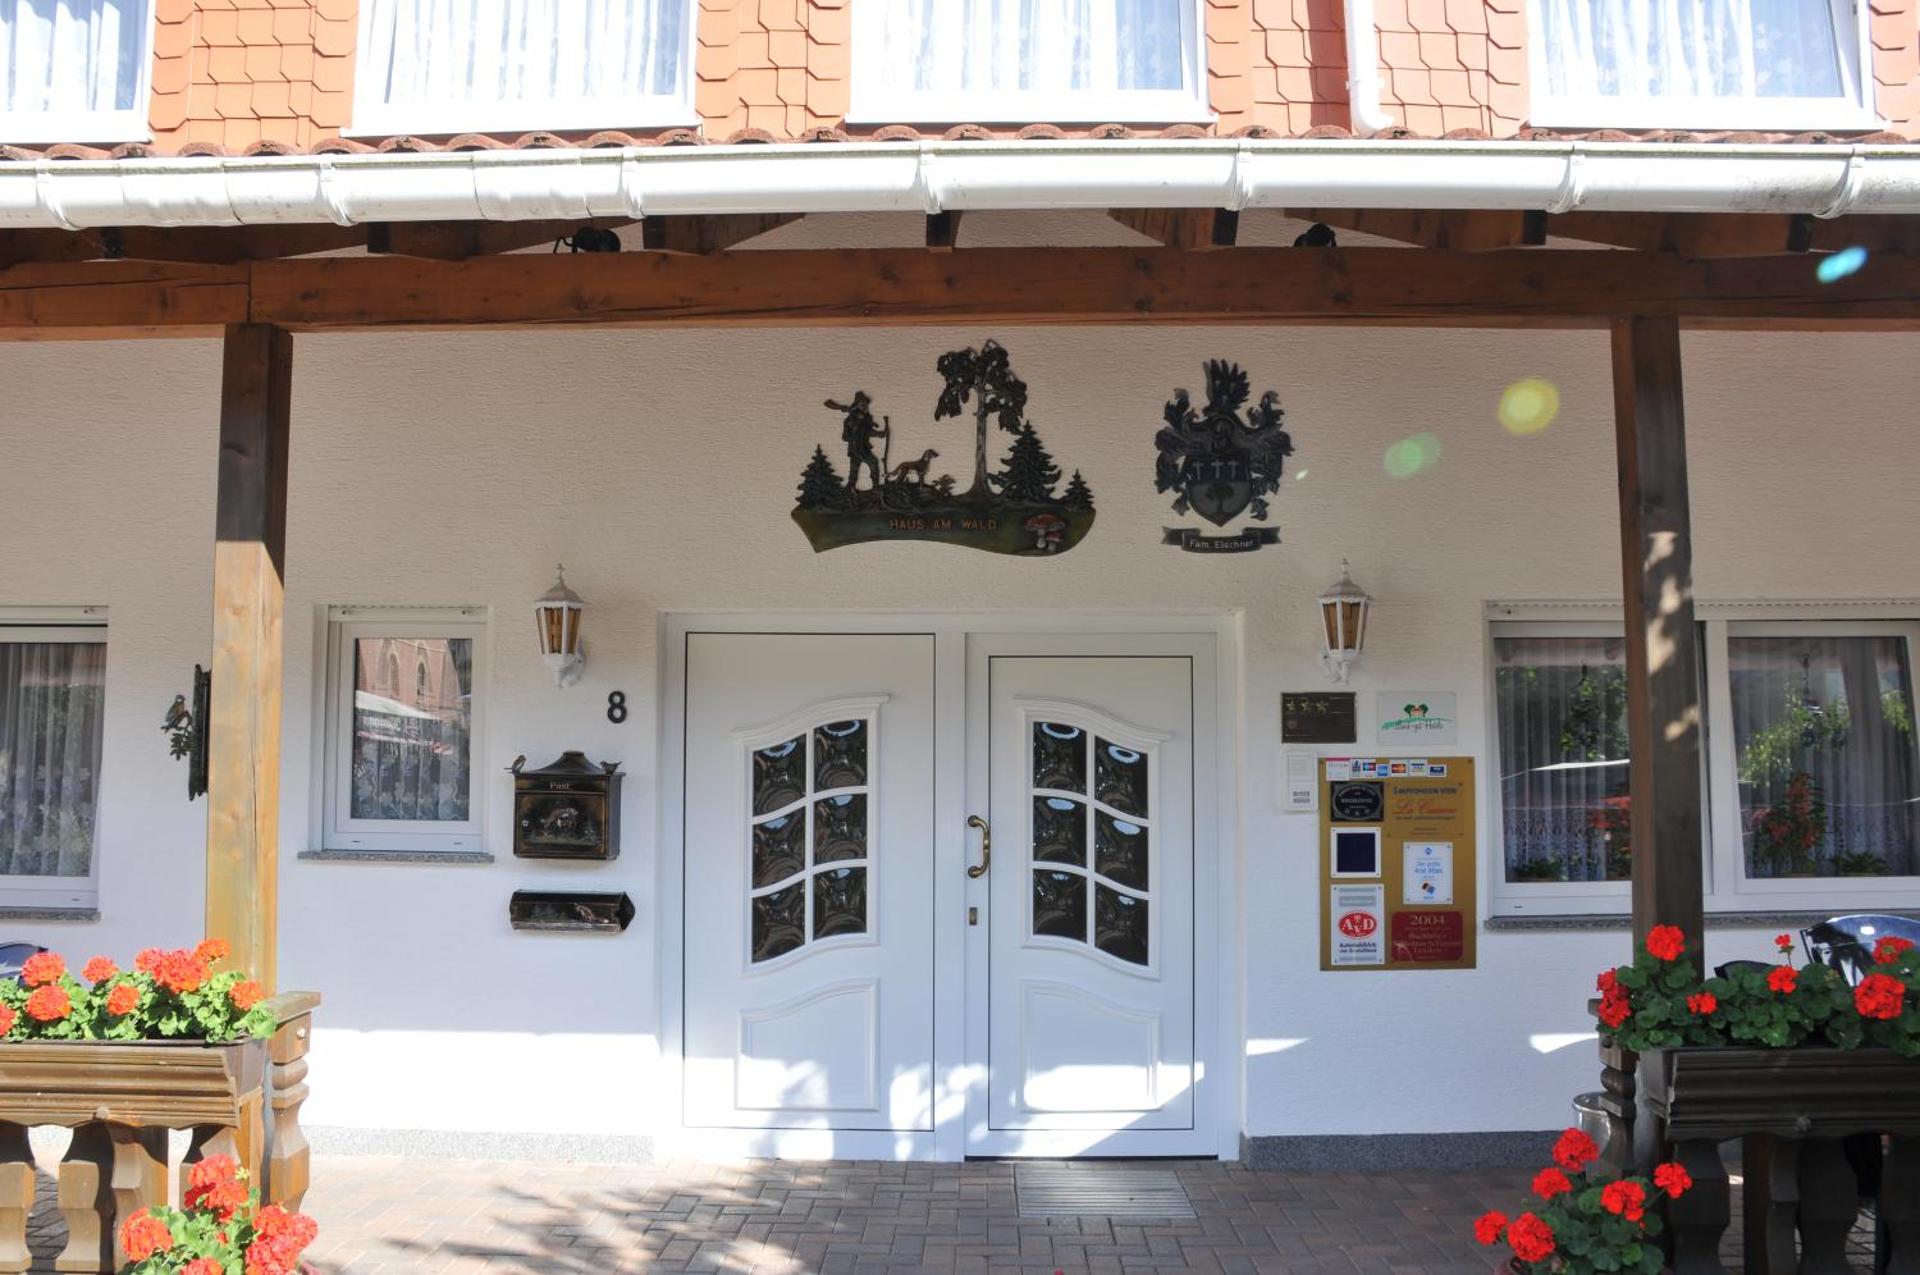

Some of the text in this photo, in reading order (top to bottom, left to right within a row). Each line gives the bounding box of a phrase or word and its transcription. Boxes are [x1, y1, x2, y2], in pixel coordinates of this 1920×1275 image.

[890, 519, 997, 529] HAUS AM WALD
[607, 691, 627, 724] 8
[1409, 915, 1445, 925] 2004
